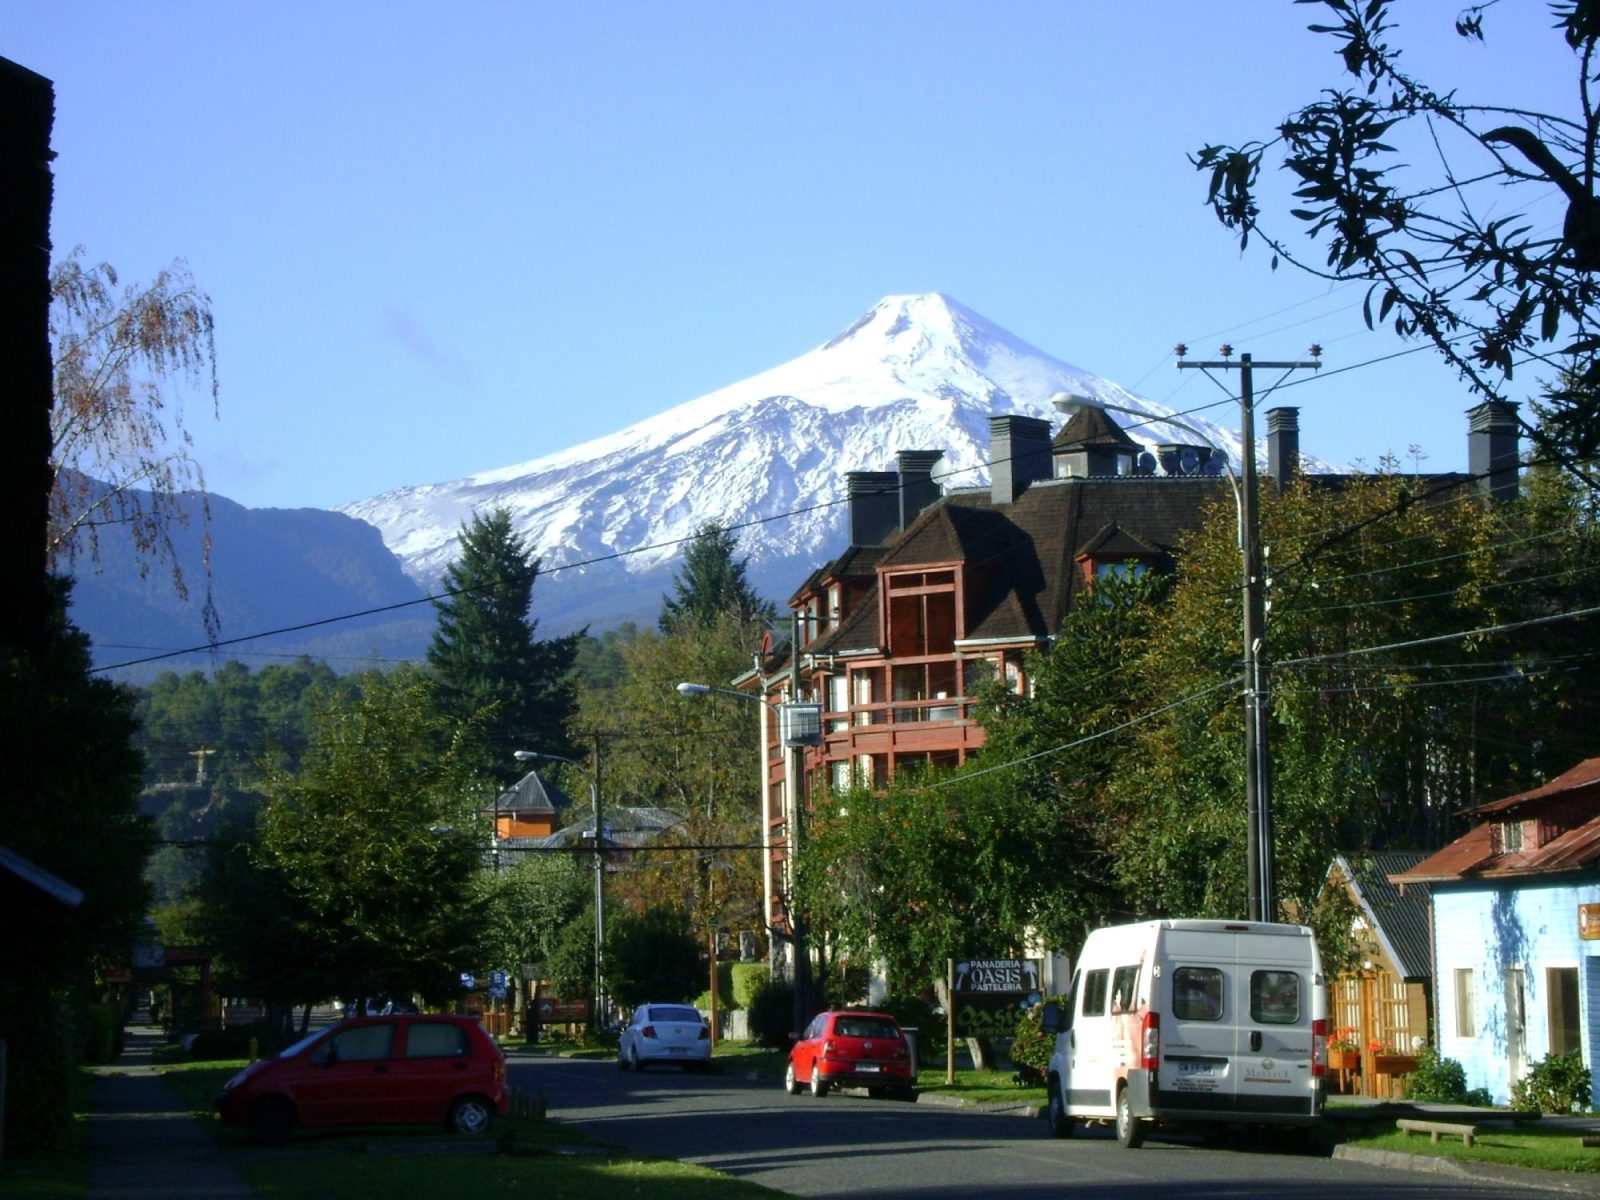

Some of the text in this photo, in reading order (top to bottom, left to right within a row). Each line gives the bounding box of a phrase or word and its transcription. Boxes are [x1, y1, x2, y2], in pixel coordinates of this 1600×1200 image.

[971, 961, 1021, 969] PANADERIA
[971, 969, 1021, 983] OASIS
[971, 983, 1022, 991] PASTELERIA
